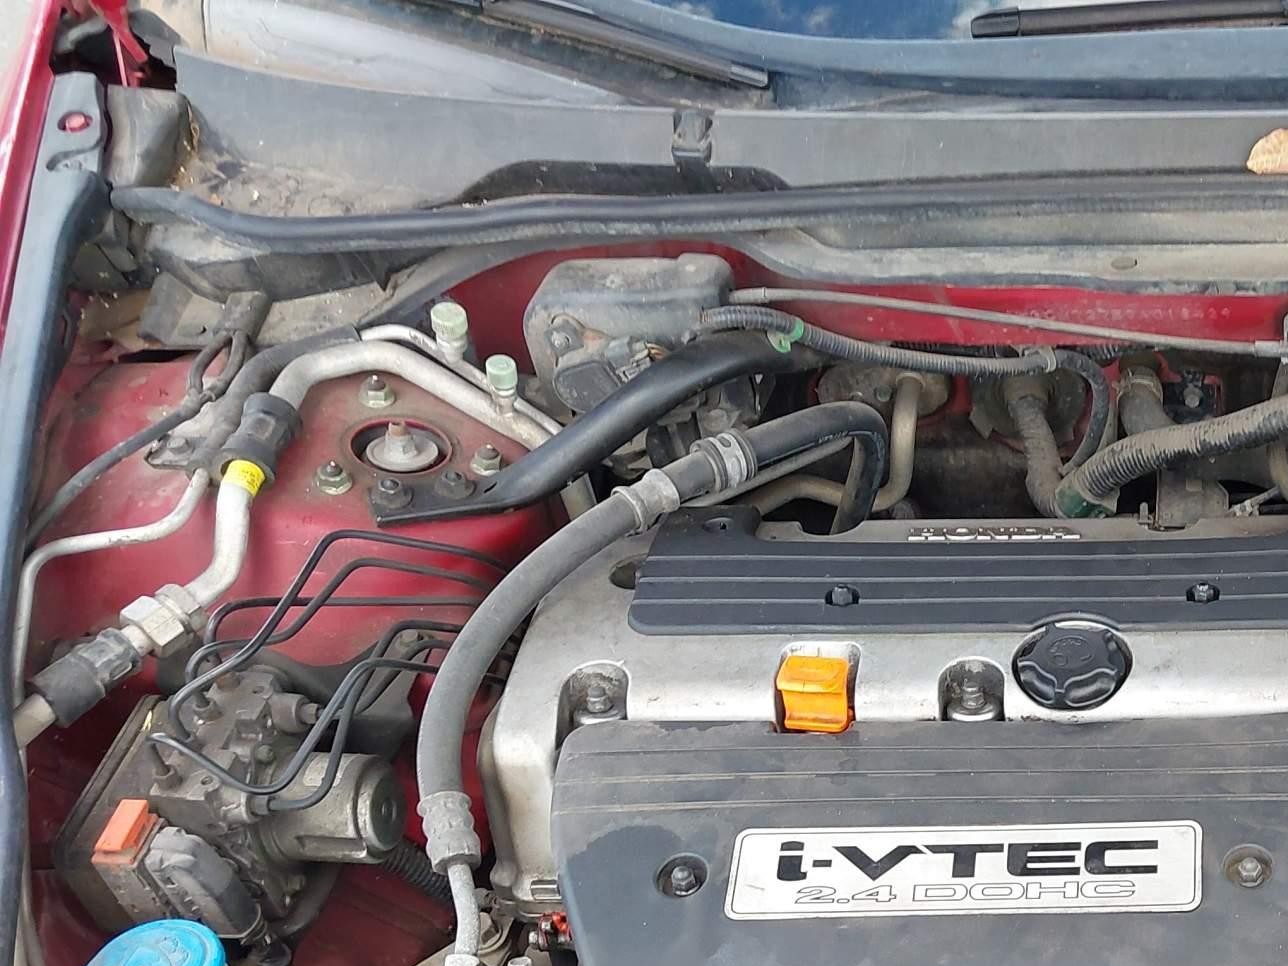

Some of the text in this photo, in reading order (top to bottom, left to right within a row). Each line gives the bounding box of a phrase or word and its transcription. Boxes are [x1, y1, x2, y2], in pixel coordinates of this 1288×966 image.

[907, 526, 1082, 542] HONDA
[776, 839, 1159, 881] i-VTEC
[794, 880, 1136, 905] 2.4 DOHC
